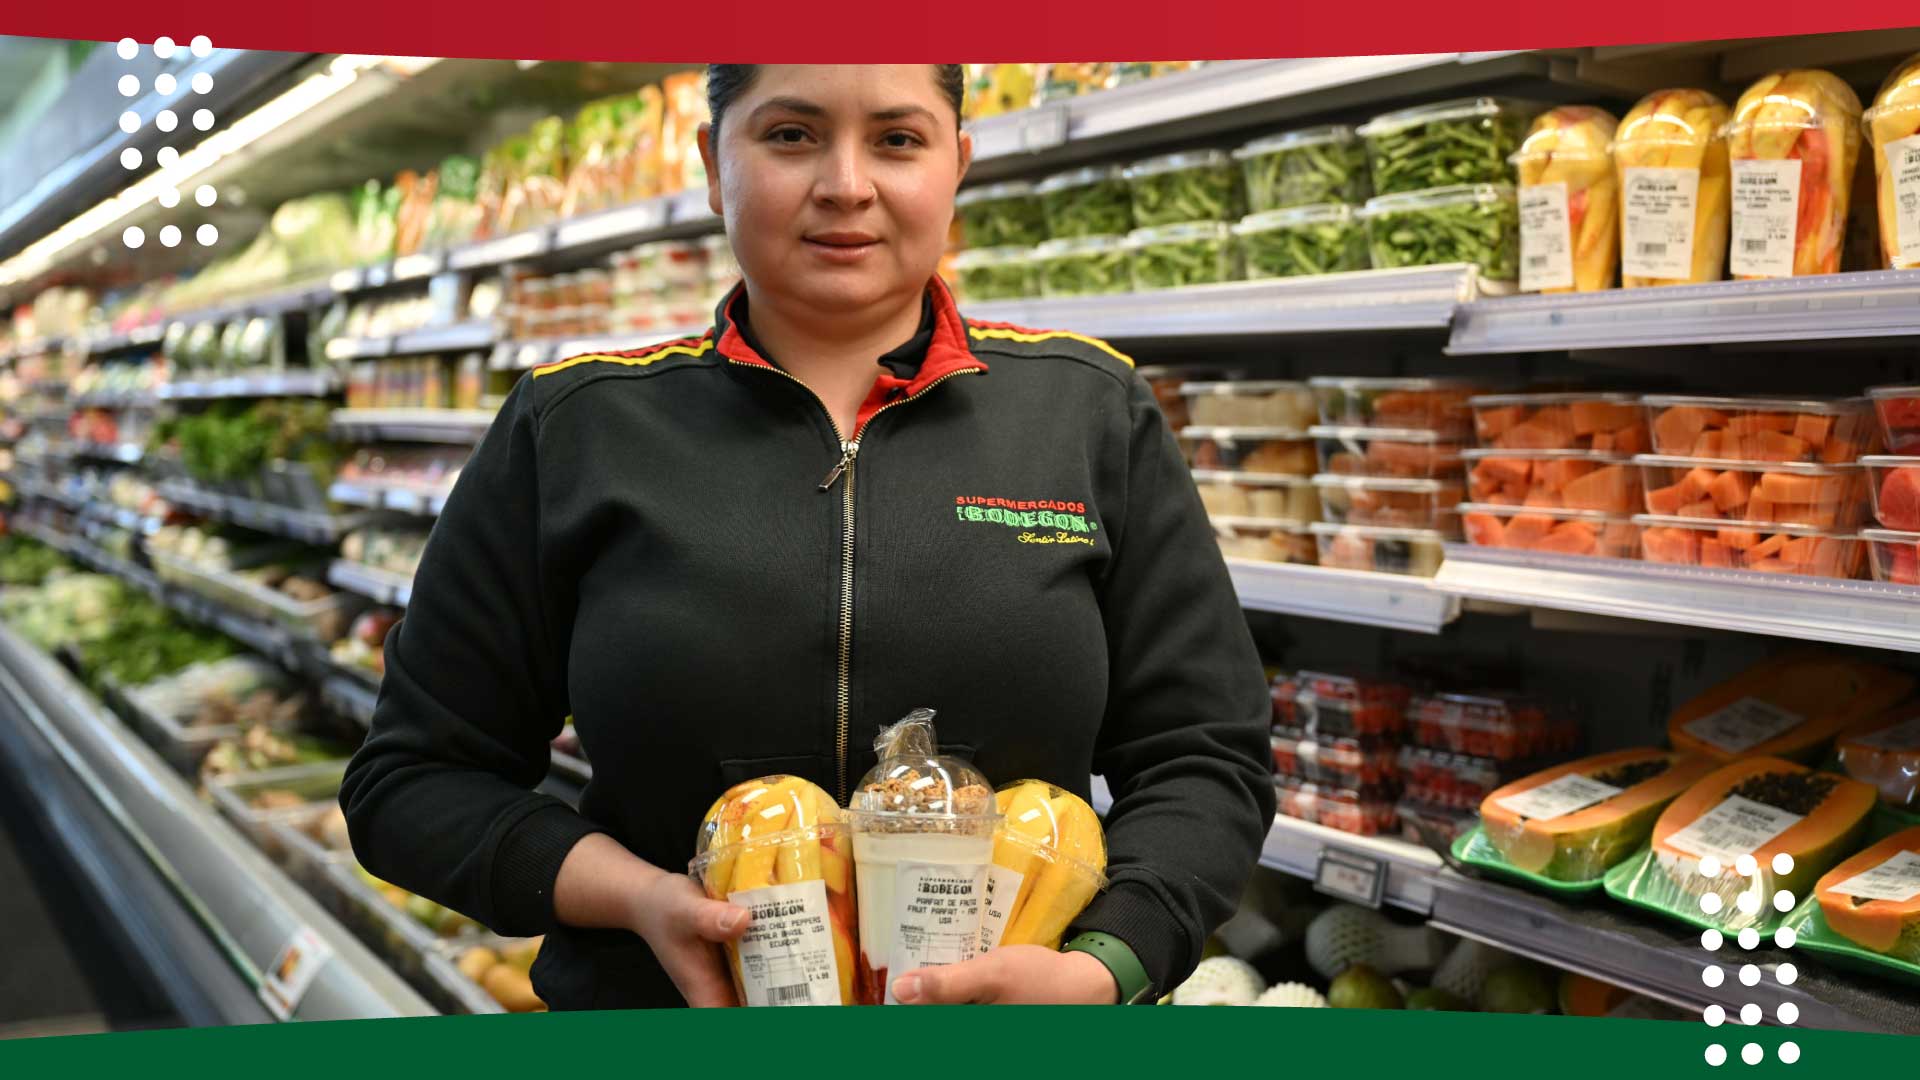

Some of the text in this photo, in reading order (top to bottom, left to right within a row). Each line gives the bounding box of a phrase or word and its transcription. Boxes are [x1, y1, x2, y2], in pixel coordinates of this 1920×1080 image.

[955, 495, 1086, 513] SUPERMERCADOS
[965, 506, 1090, 533] BODEGON
[751, 905, 804, 920] BODEGON
[989, 909, 1002, 919] USA
[791, 916, 821, 926] PEPPERS
